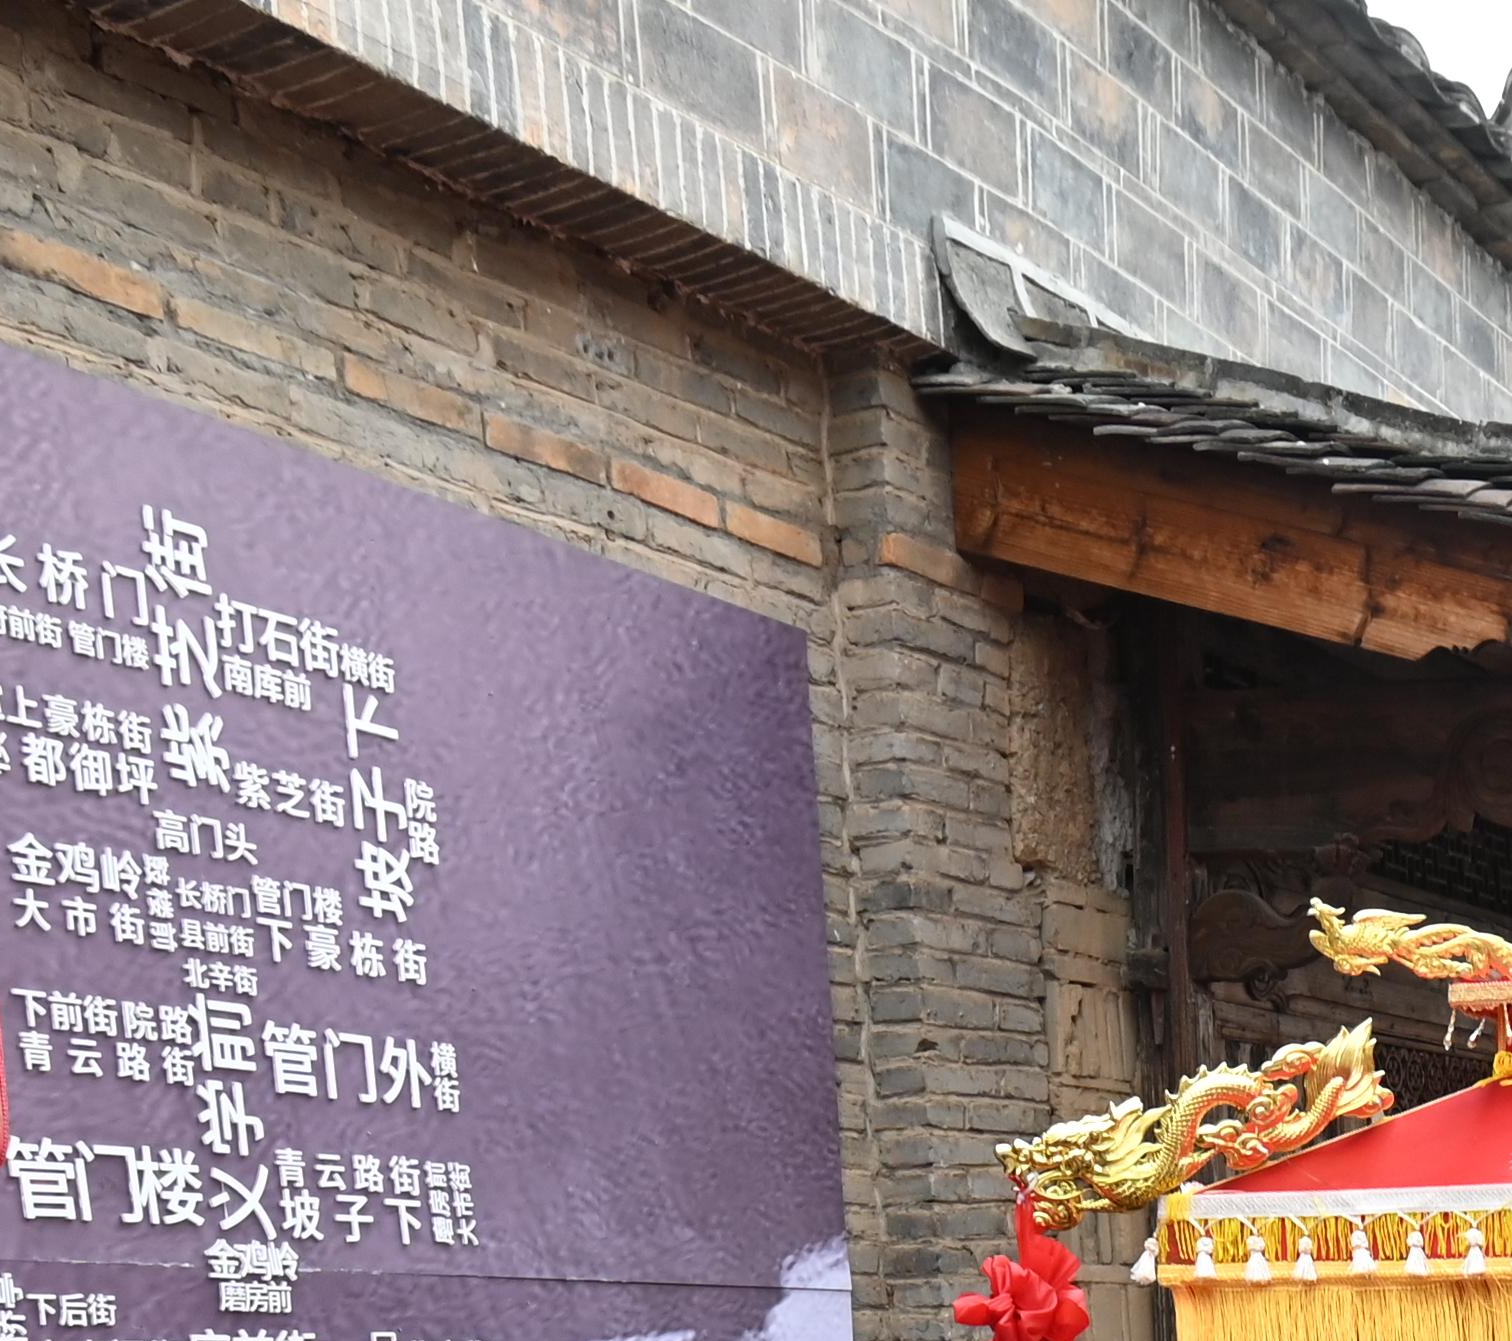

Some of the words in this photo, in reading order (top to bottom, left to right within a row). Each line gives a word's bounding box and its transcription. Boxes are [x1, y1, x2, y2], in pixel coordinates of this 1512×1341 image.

[68, 619, 150, 670] 管门楼
[214, 592, 340, 679] 打石街
[339, 642, 396, 694] 横街
[221, 654, 312, 711] 南库前
[6, 684, 152, 757] 上豪栋街
[22, 730, 158, 805] 都御坪
[233, 760, 346, 827] 紫芝街
[152, 809, 258, 865] 高门头
[403, 778, 440, 865] 院路
[7, 832, 143, 900] 金鸡岭
[13, 888, 145, 945] 大市街
[175, 877, 252, 918] 长桥门
[251, 874, 343, 928] 管门楼
[180, 918, 255, 957] 县前街
[256, 916, 427, 985] 下豪栋街
[182, 957, 258, 996] 北辛街
[11, 988, 118, 1037] 下前街
[121, 999, 194, 1045] 院路
[19, 1030, 195, 1086] 青云路街
[261, 1019, 433, 1108] 管门外
[430, 1041, 461, 1113] 横街
[5, 1135, 205, 1226] 管门楼
[275, 1147, 421, 1196] 青云路街
[279, 1188, 422, 1245] 坡子下
[204, 1238, 299, 1281] 金鸡岭
[26, 1293, 117, 1327] 下后街
[220, 1280, 292, 1313] 磨房前
